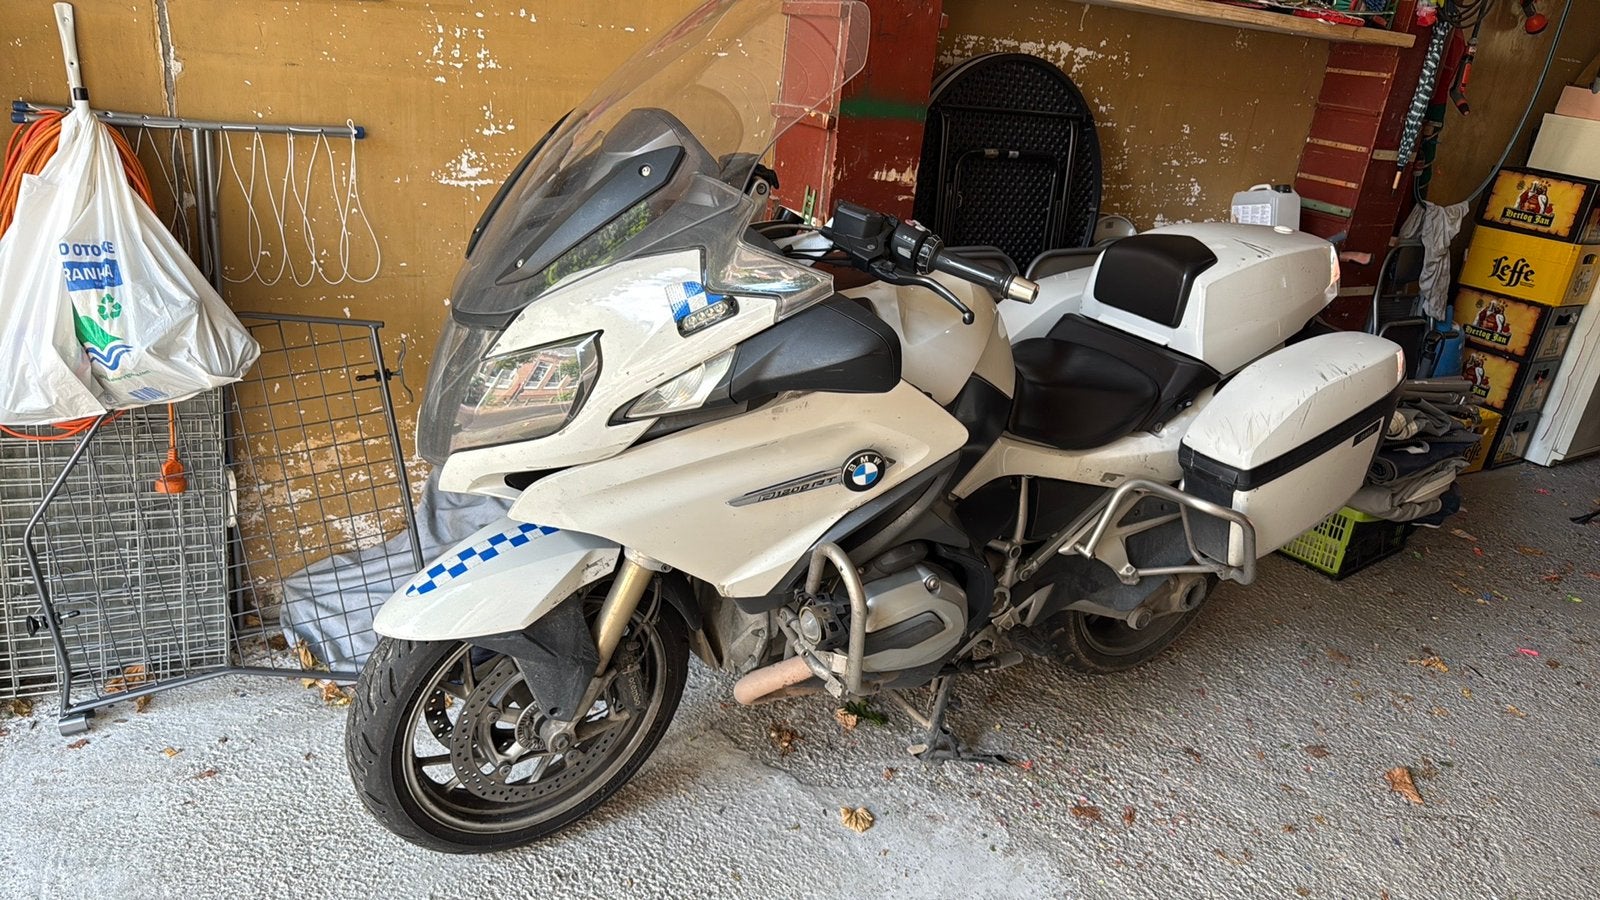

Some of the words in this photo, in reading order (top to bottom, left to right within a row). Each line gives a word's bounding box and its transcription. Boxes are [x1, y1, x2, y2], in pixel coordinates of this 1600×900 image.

[1533, 213, 1550, 226] Jan
[1488, 255, 1535, 288] Leffe
[847, 455, 882, 472] BMW
[629, 677, 641, 706] brembo
